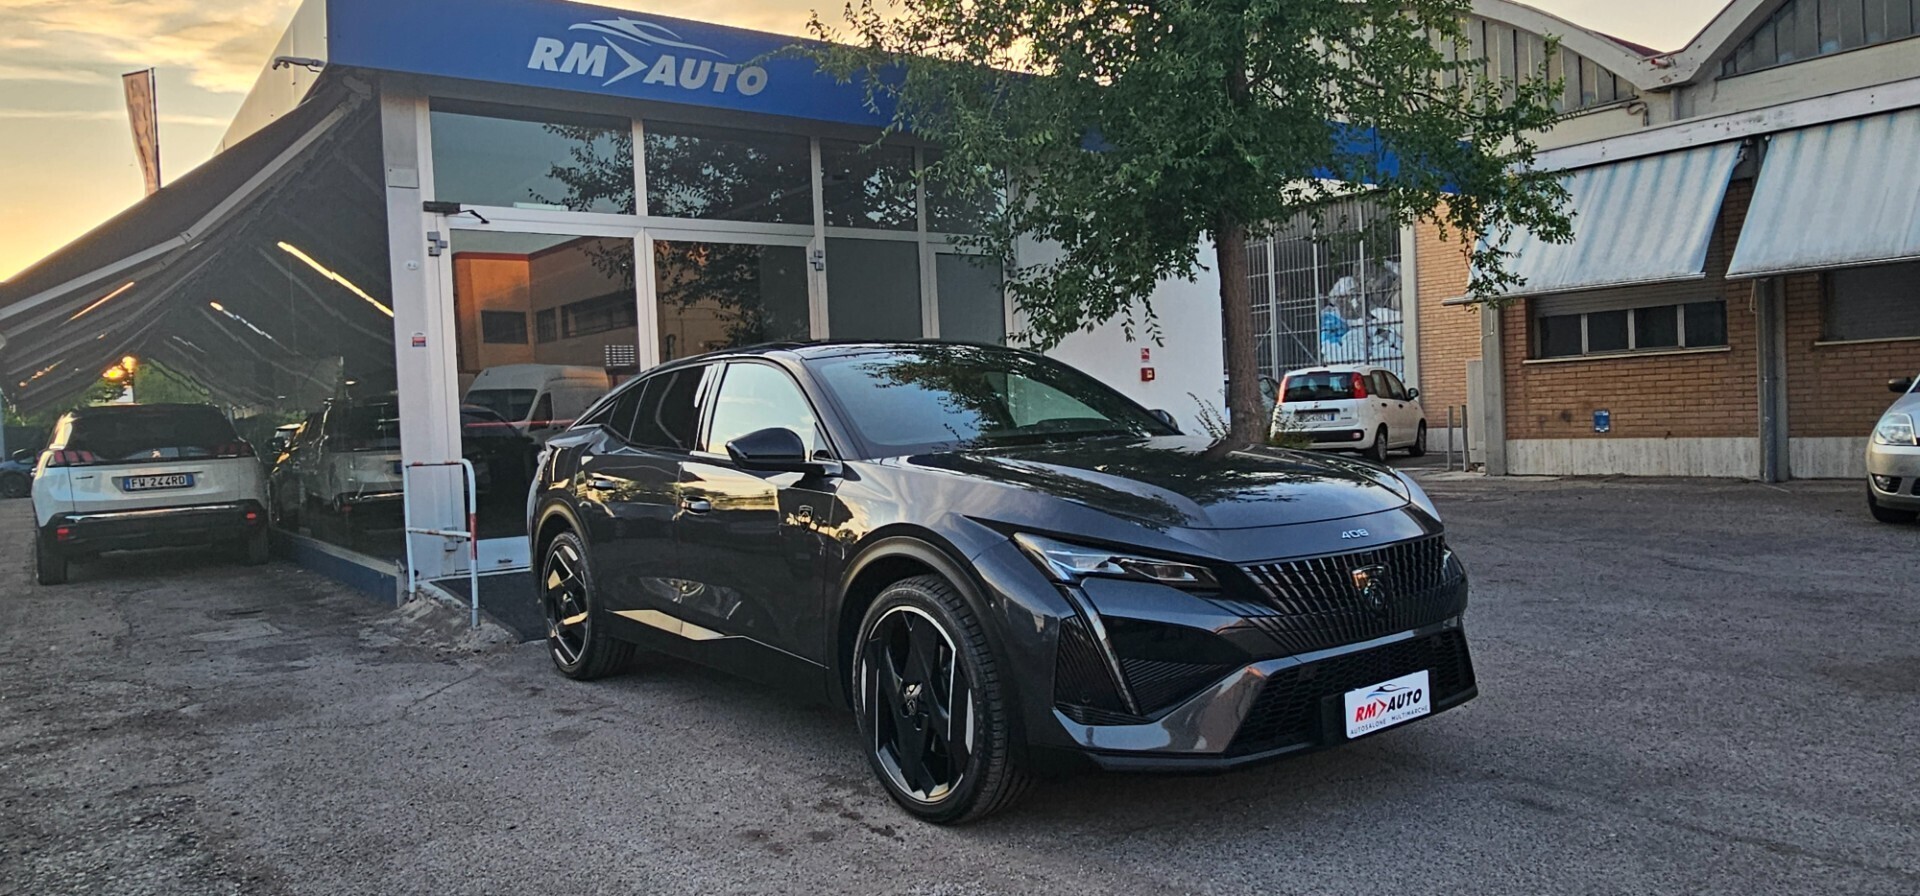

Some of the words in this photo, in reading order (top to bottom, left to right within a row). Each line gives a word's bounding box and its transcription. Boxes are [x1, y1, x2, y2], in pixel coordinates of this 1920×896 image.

[527, 36, 608, 77] RM
[642, 54, 768, 96] AUTO
[150, 475, 186, 487] 244RD
[1342, 528, 1369, 539] 408
[1350, 718, 1387, 735] AUTOSALONE
[1391, 705, 1428, 721] MULTIMARCHE
[1355, 702, 1377, 722] RM
[1387, 688, 1422, 712] AUTO
